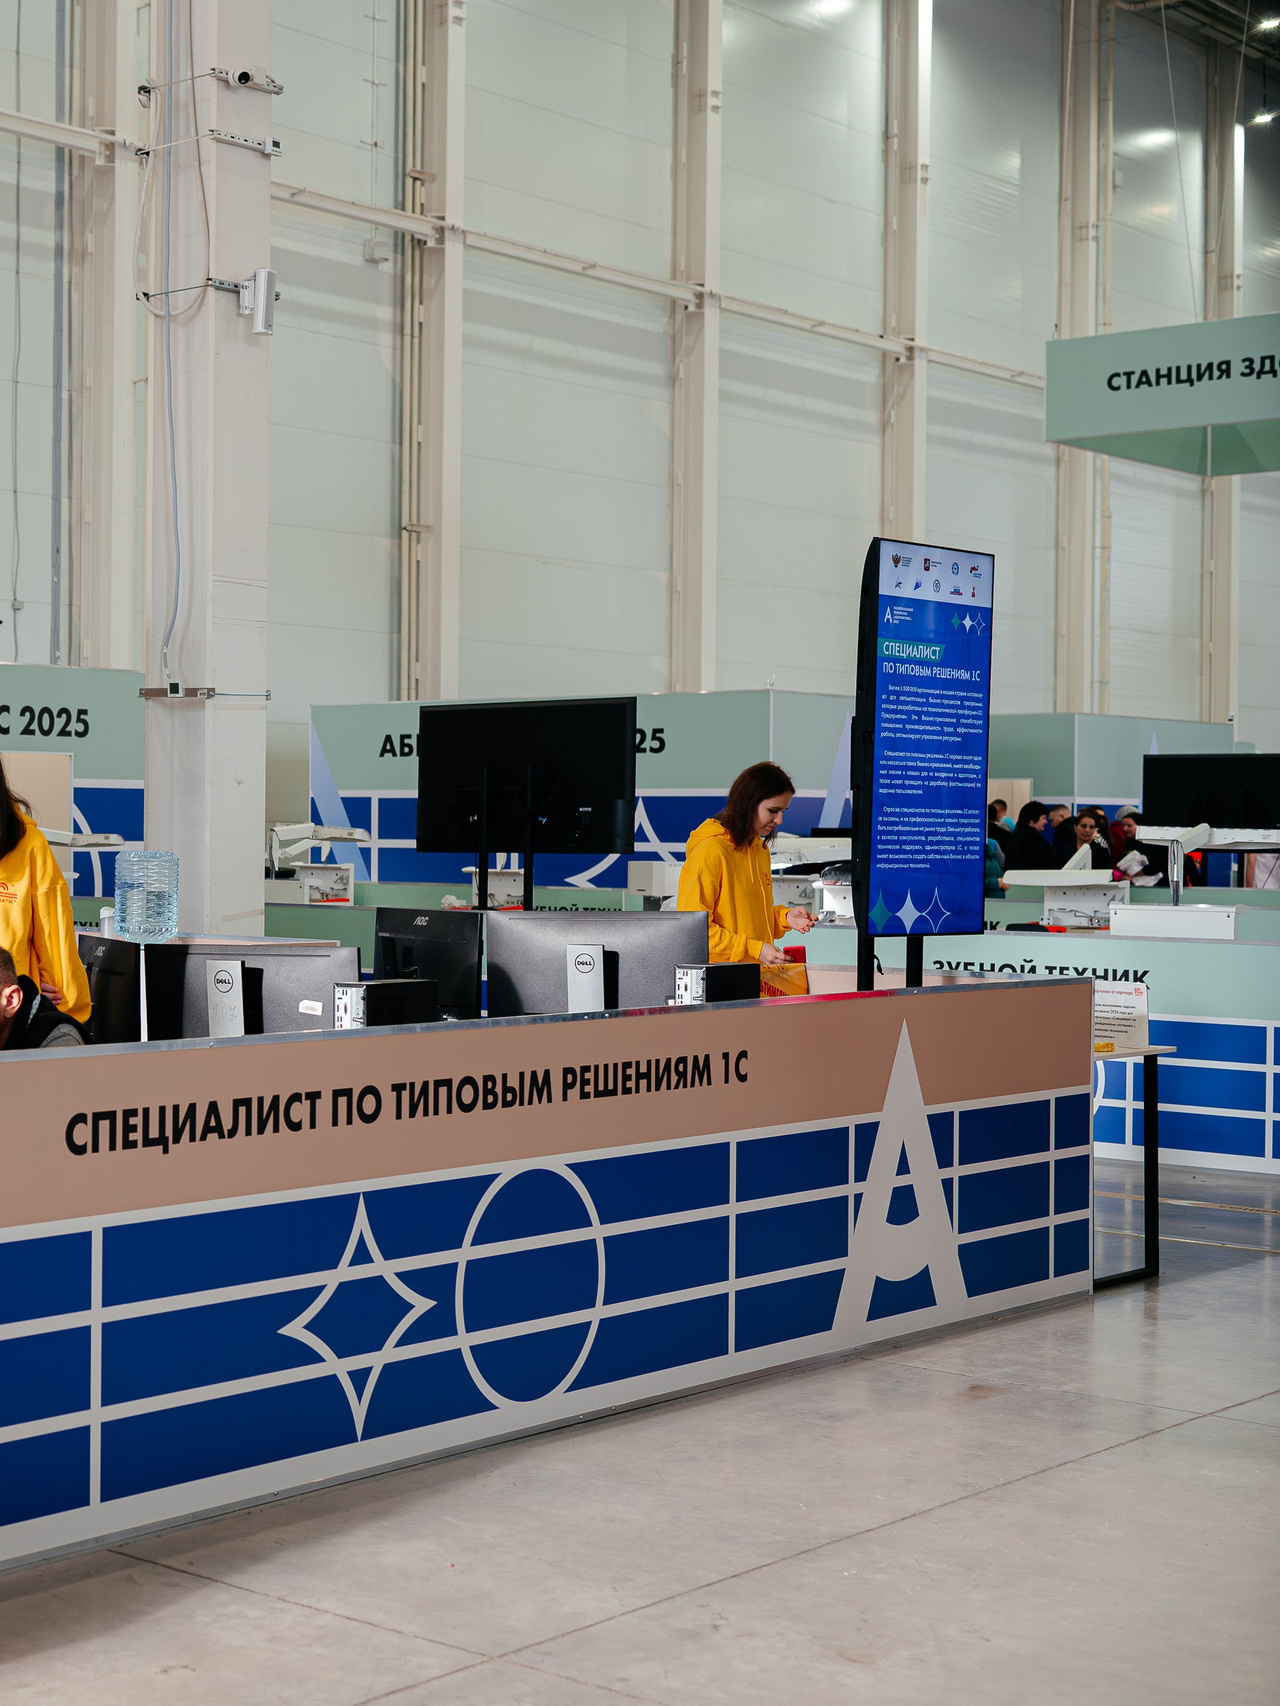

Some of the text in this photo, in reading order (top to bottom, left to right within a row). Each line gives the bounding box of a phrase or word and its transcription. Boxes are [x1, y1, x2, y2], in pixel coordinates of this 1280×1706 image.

[1107, 360, 1231, 391] СТАНЦИЯ
[883, 641, 941, 660] СПЕЦИАЛИСТ
[883, 662, 981, 682] ПО ТИПОВЫМ РЕШЕНИЯМ 1С
[20, 706, 89, 738] 2025
[379, 728, 666, 758] АБ 25
[216, 978, 232, 986] DELL
[66, 1050, 748, 1155] СПЕЦИАЛИСТ ПО ТИПОВЫМ РЕШЕНИЯМ 1С
